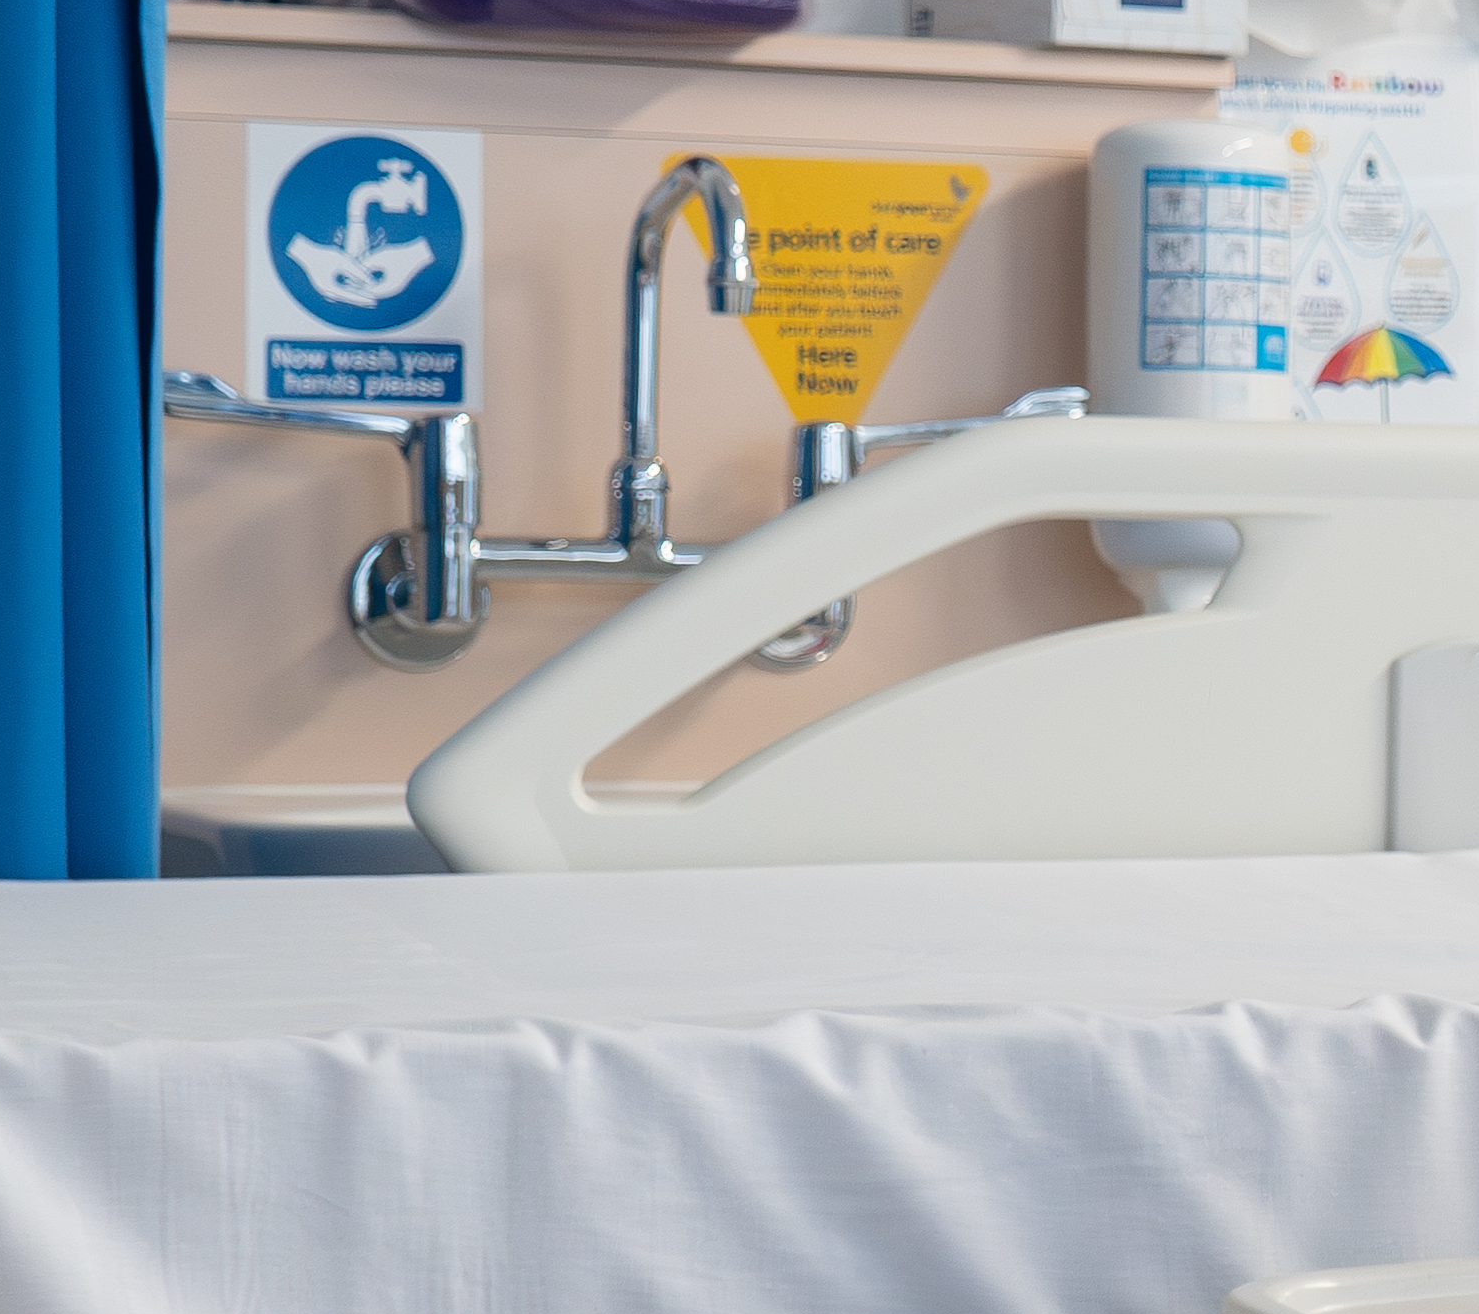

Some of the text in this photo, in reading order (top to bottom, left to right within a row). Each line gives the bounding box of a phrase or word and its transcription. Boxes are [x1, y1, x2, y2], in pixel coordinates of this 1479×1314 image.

[1327, 69, 1447, 98] Rainbow
[767, 223, 841, 255] point
[847, 224, 878, 253] of
[884, 230, 942, 255] care
[271, 342, 458, 377] Now wash your
[796, 343, 858, 367] Here
[283, 369, 446, 400] hands please
[796, 370, 860, 396] Now
